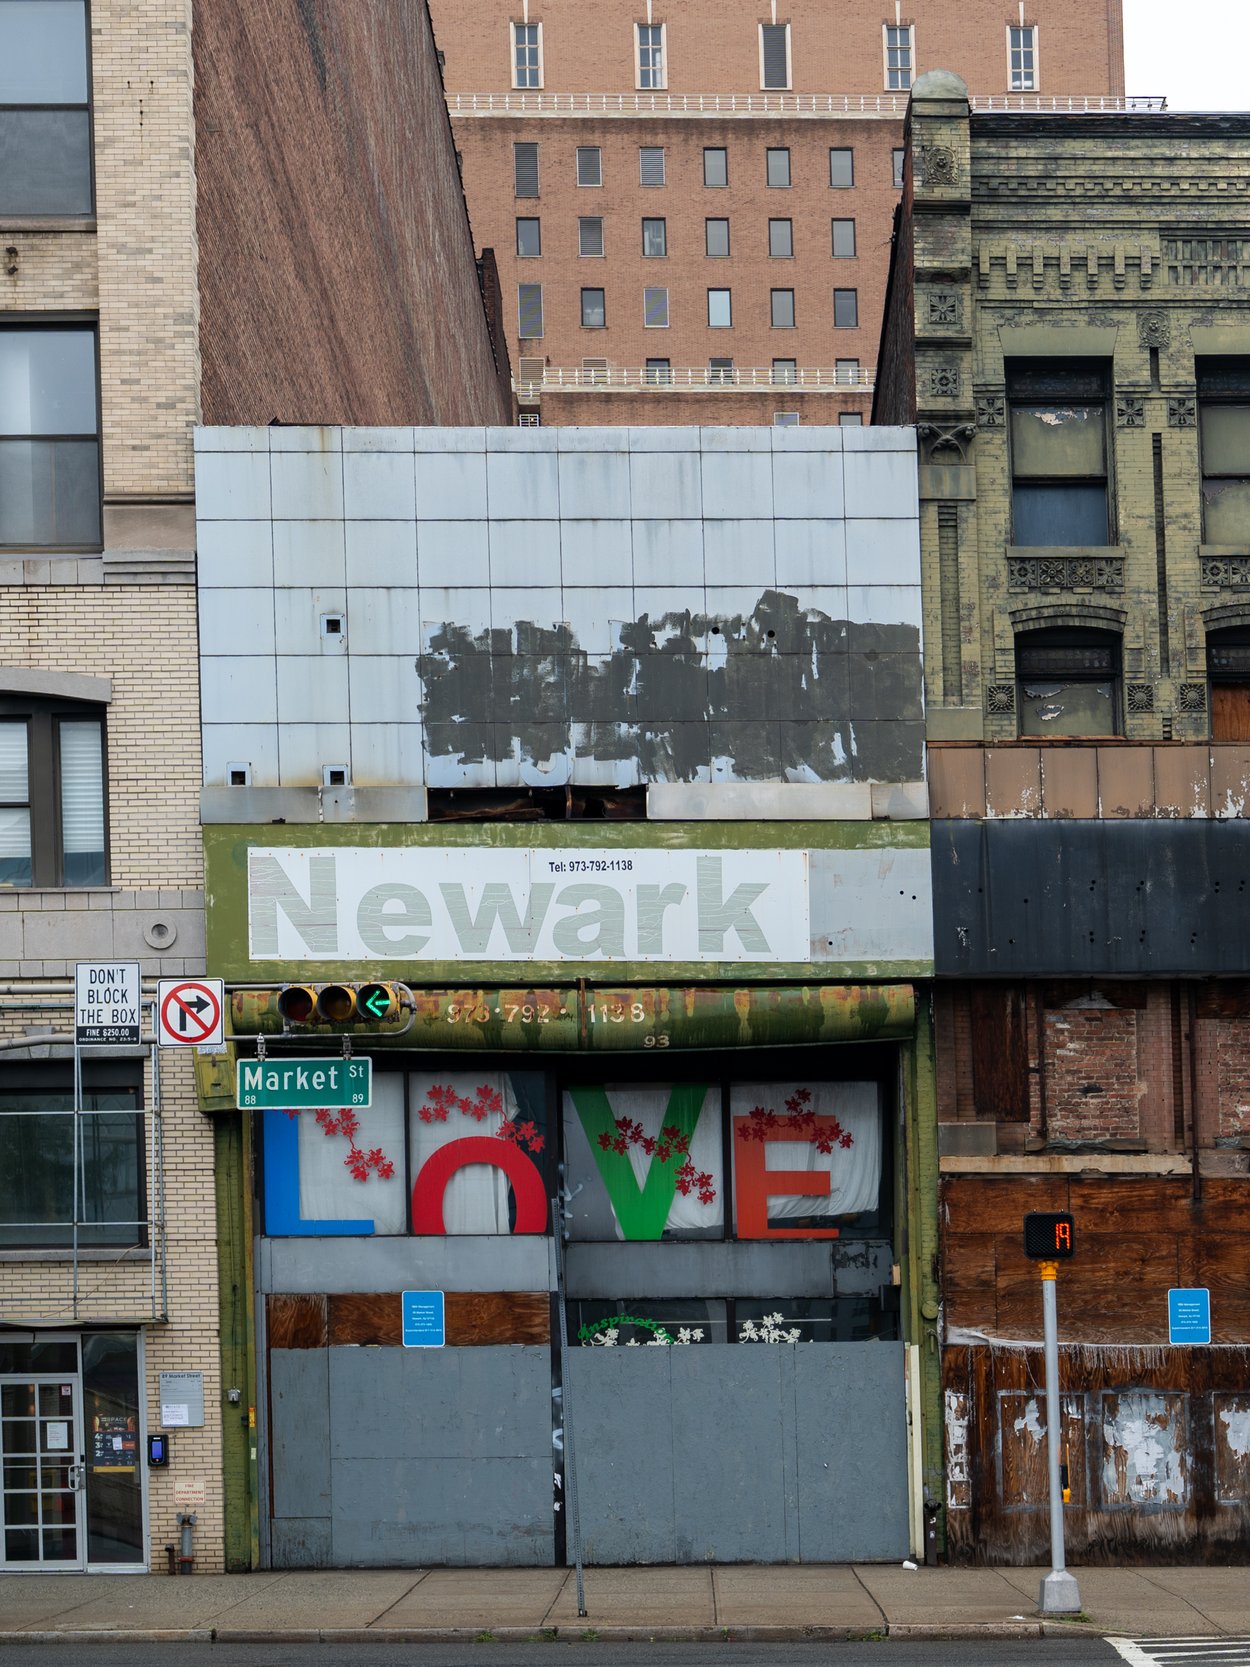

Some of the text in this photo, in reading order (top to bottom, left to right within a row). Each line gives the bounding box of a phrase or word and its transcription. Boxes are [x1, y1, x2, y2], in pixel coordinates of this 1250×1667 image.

[549, 860, 633, 873] Tel: 973-792-1138
[249, 856, 773, 957] Newark
[89, 968, 126, 984] DON'T
[87, 988, 129, 1004] BLOCK
[80, 1008, 136, 1024] THE BOX
[86, 1028, 130, 1037] FINE $250.00
[643, 1035, 670, 1048] 93
[244, 1065, 364, 1091] Market St
[244, 1095, 256, 1105] 88
[352, 1093, 364, 1103] 89
[1055, 1223, 1070, 1250] 19
